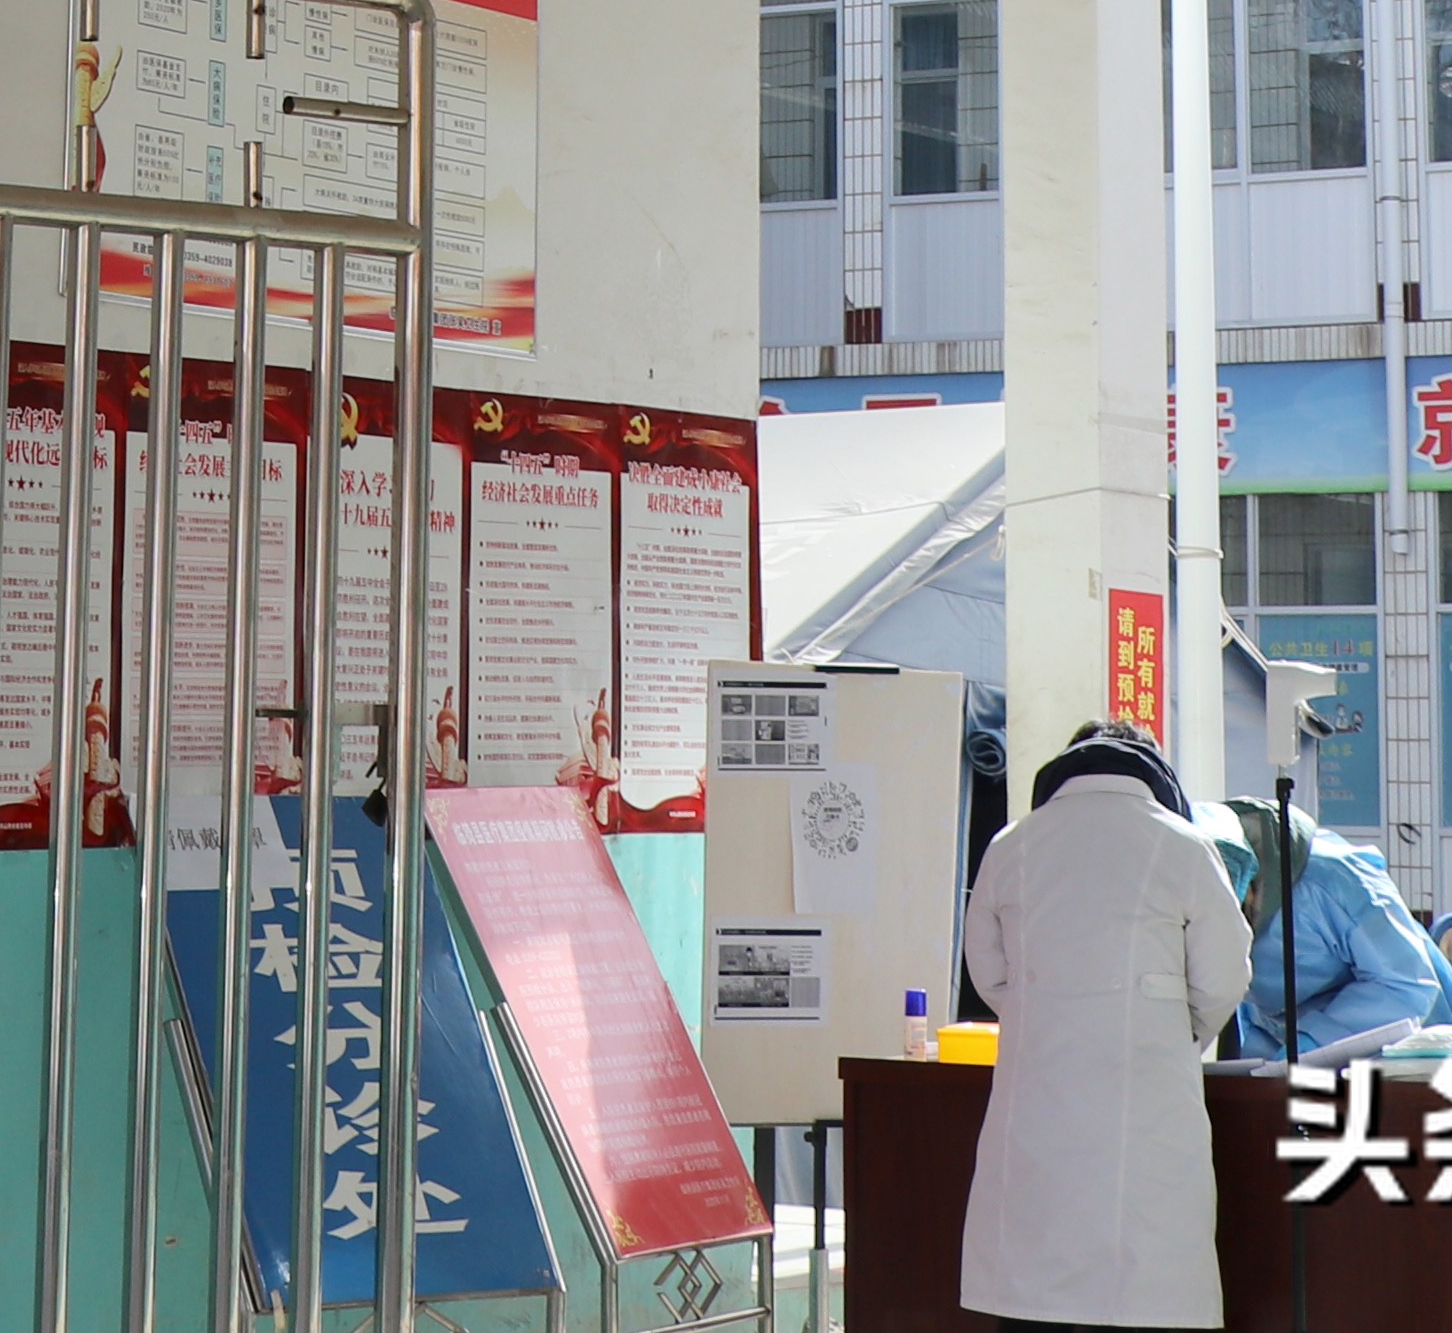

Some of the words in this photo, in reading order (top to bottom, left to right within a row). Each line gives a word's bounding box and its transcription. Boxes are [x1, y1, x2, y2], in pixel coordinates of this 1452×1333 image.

[481, 480, 601, 509] 经济社会发展重点任务
[647, 493, 724, 519] 取得决定性成就
[1137, 626, 1156, 738] 所有就
